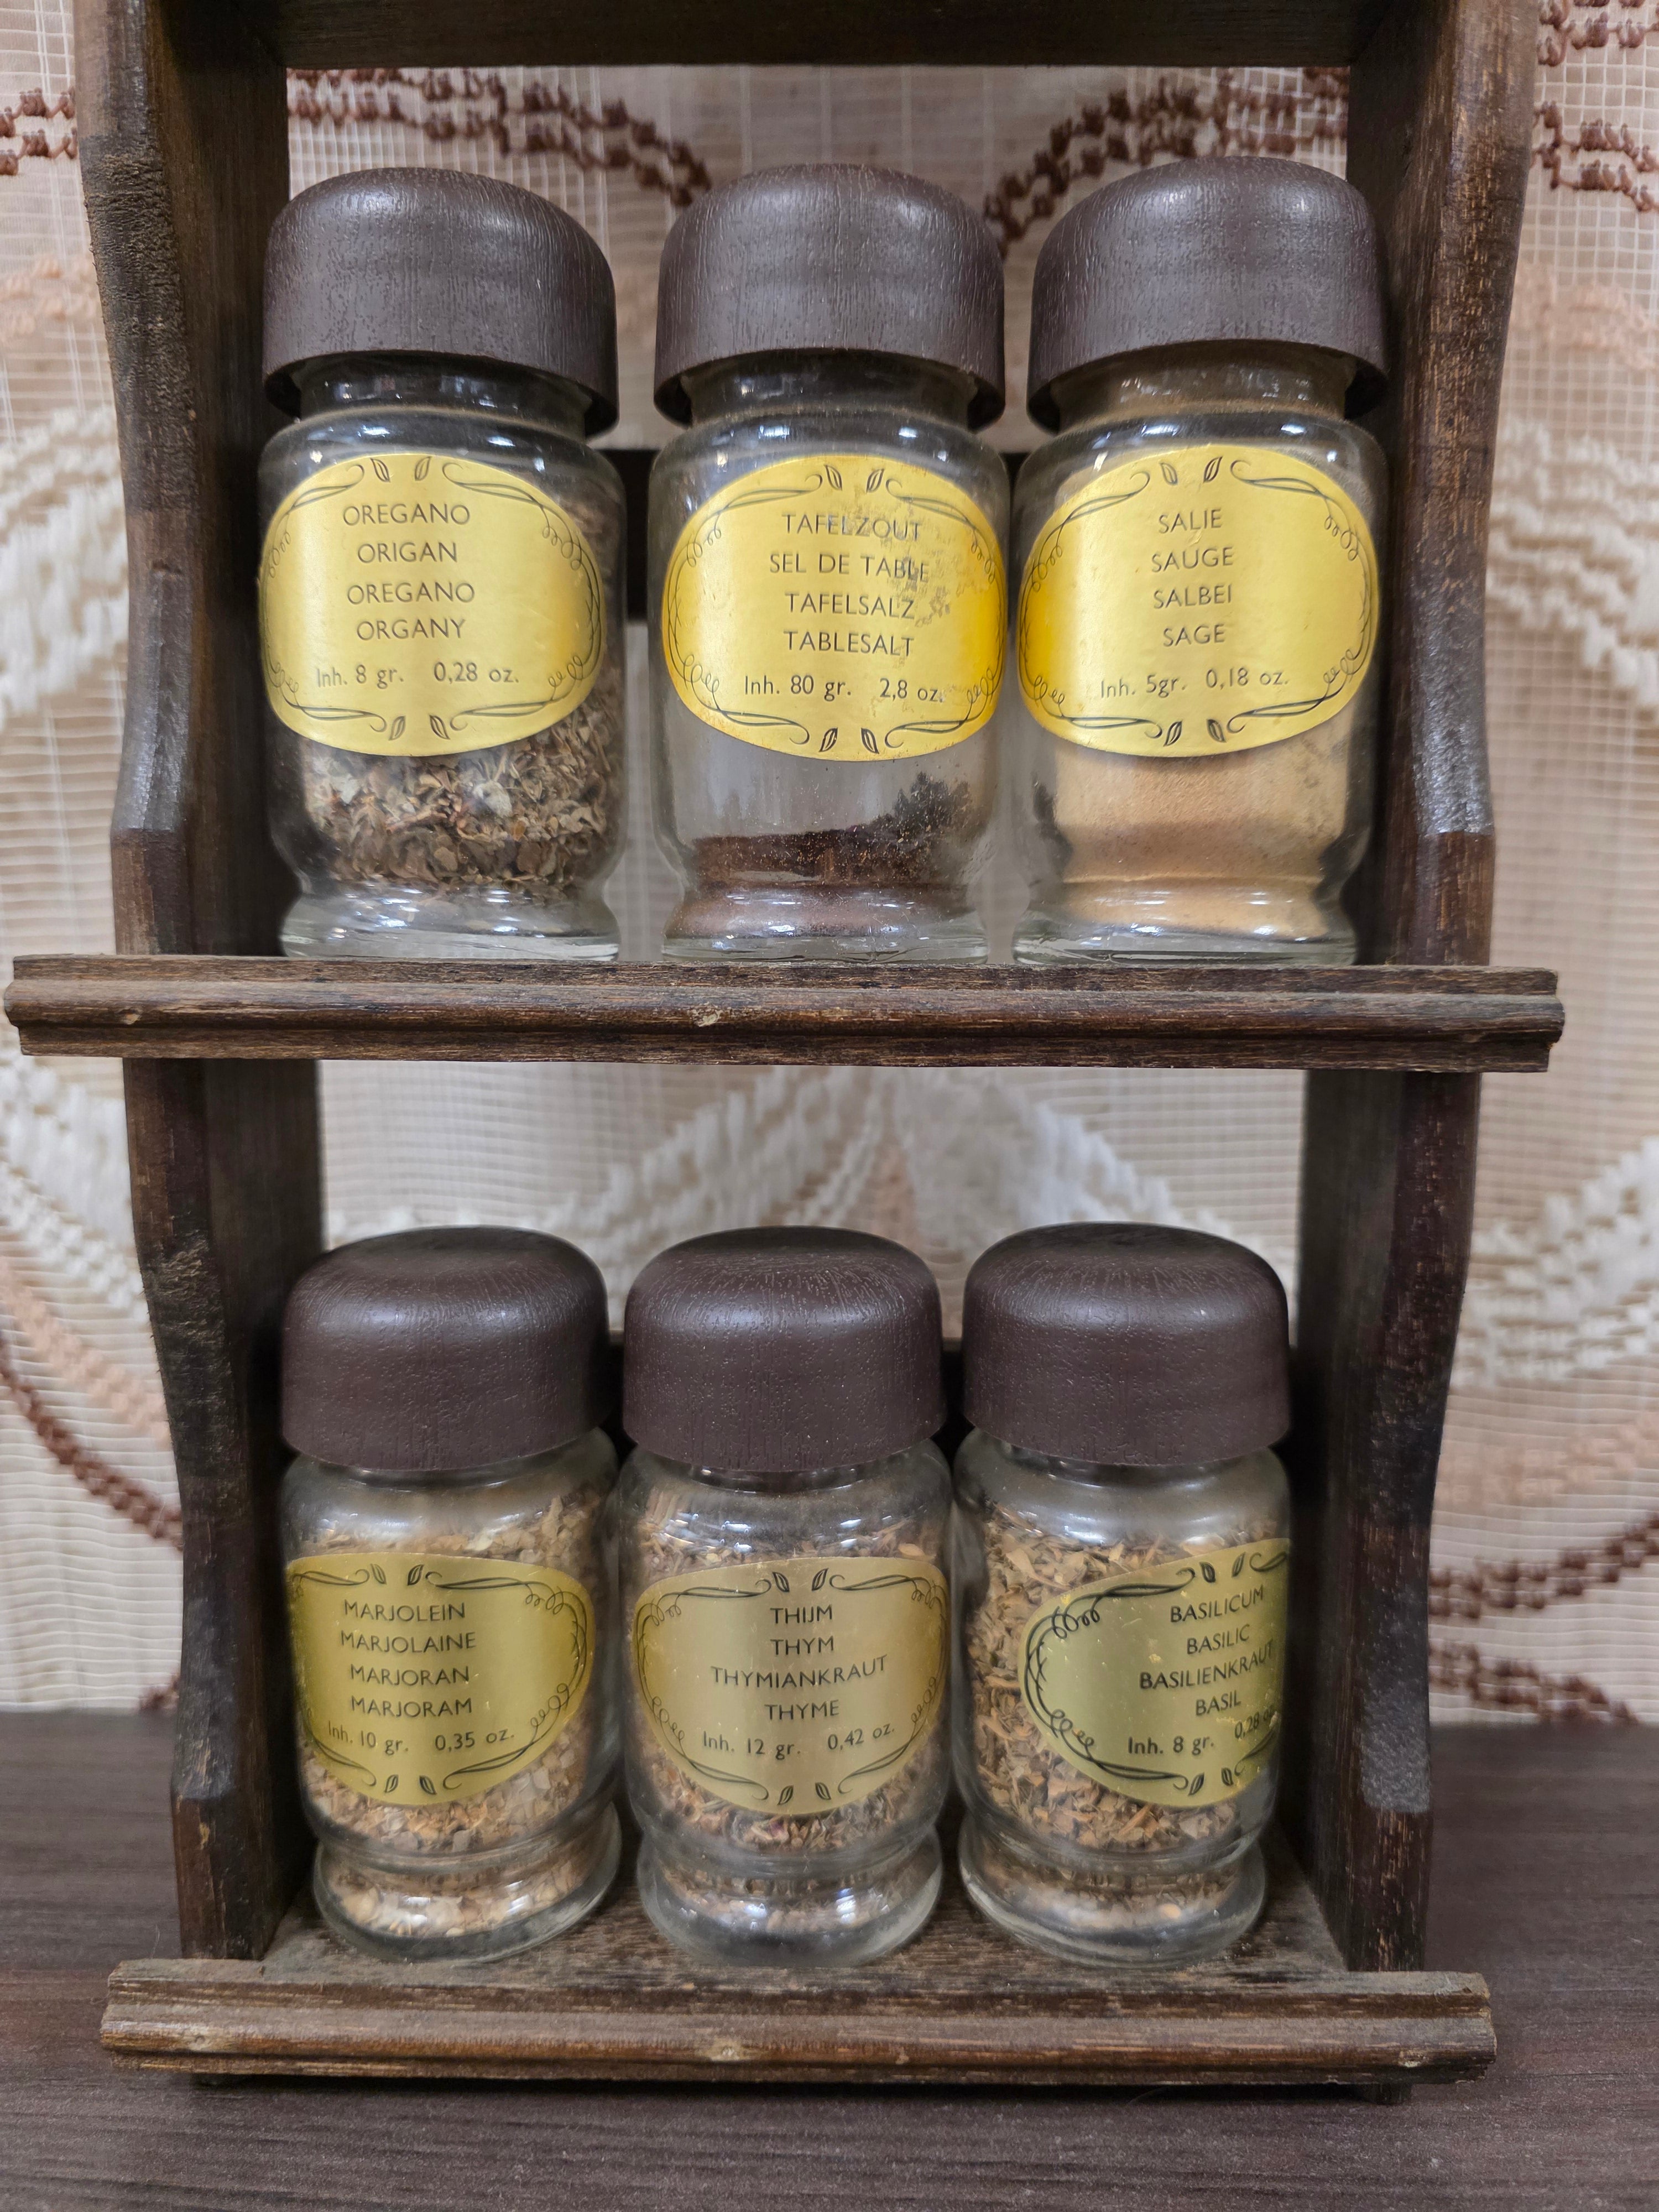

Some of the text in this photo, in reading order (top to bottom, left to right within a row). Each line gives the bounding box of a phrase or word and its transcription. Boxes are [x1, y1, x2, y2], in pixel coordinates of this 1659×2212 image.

[343, 503, 471, 526] OREGANO
[781, 513, 920, 541] TAFELZOUT
[1157, 508, 1223, 534] SALIE
[357, 542, 458, 564] ORIGAN
[1151, 546, 1234, 573] SAUGE
[770, 552, 929, 583] SEL DE TABLE
[347, 582, 475, 605] OREGANO
[785, 593, 916, 620] TAFELSALZ
[1153, 584, 1233, 609] SALBEI
[357, 619, 466, 640] ORGANY
[1162, 624, 1225, 647] SAGE
[784, 631, 915, 658] TABLESALT
[317, 662, 519, 690] Inh. 8 gr. 0,28 oz.
[745, 675, 780, 695] Inh.
[790, 674, 814, 695] 80
[823, 681, 851, 702] gr.
[879, 677, 908, 702] 2,8
[1100, 667, 1288, 698] Inh. 5gr. 0,18 oz.
[344, 1599, 466, 1622] MARJOLEIN
[770, 1605, 833, 1624] THIJM
[1170, 1584, 1264, 1624] BASILICUM
[341, 1630, 477, 1653] MARJOLAINE
[770, 1636, 834, 1655] THYM
[1187, 1624, 1250, 1655] BASILIC
[350, 1664, 469, 1686] MARJORAN
[711, 1655, 887, 1689] THYMIANKRAUT
[1139, 1639, 1273, 1690] BASILIENKRAUT
[351, 1695, 472, 1718] MARJORAM
[764, 1699, 839, 1721] THYME
[1196, 1690, 1241, 1716] BASIL
[328, 1720, 514, 1755] Inh. 10 gr. 0,35 oz.
[702, 1723, 895, 1760] Inh. 12 gr. 0,42 oz.
[1128, 1736, 1164, 1755] Inh.
[1173, 1735, 1184, 1754] 8
[1191, 1736, 1214, 1756] gr.
[1234, 1711, 1260, 1739] 0,28
